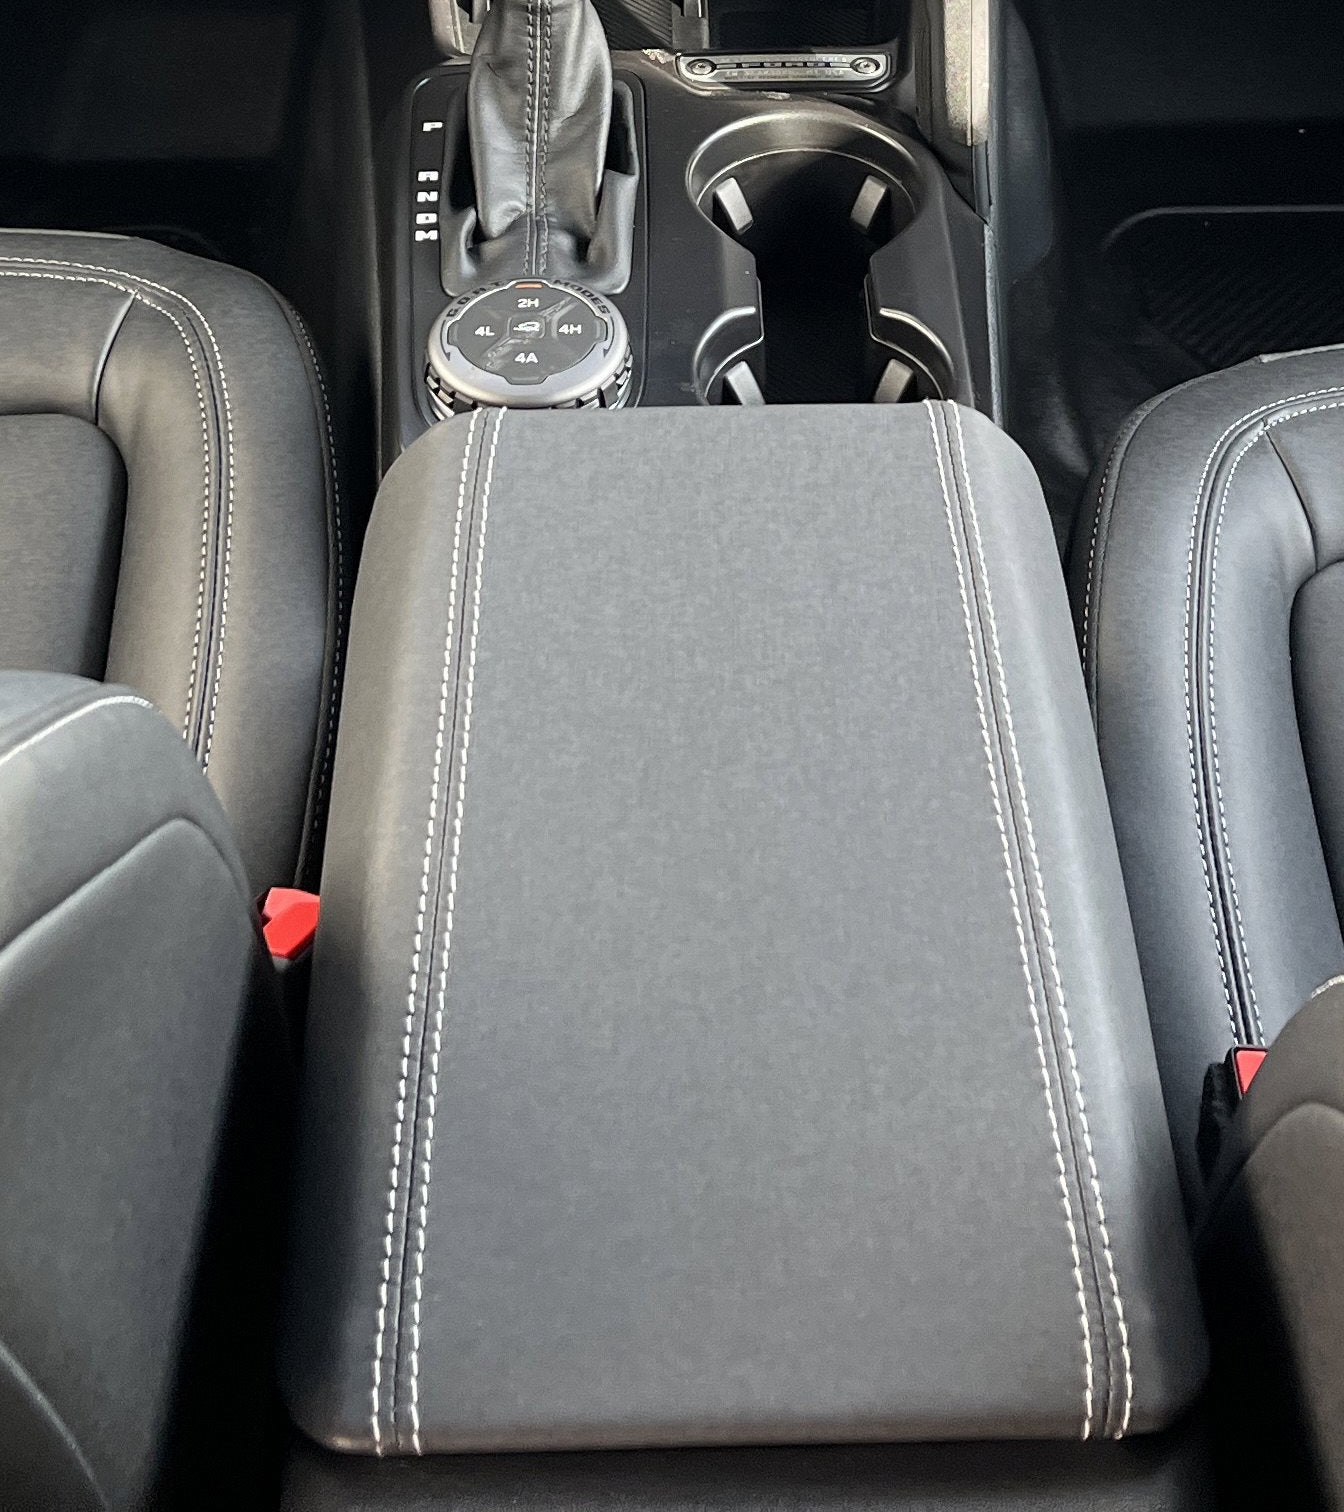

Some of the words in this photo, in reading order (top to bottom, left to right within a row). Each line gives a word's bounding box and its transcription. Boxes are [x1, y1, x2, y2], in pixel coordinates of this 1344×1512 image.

[417, 191, 438, 203] N
[414, 229, 438, 242] M
[517, 298, 540, 309] 2H
[474, 326, 496, 337] 4L
[558, 323, 582, 335] 4H
[514, 352, 539, 364] 4A
